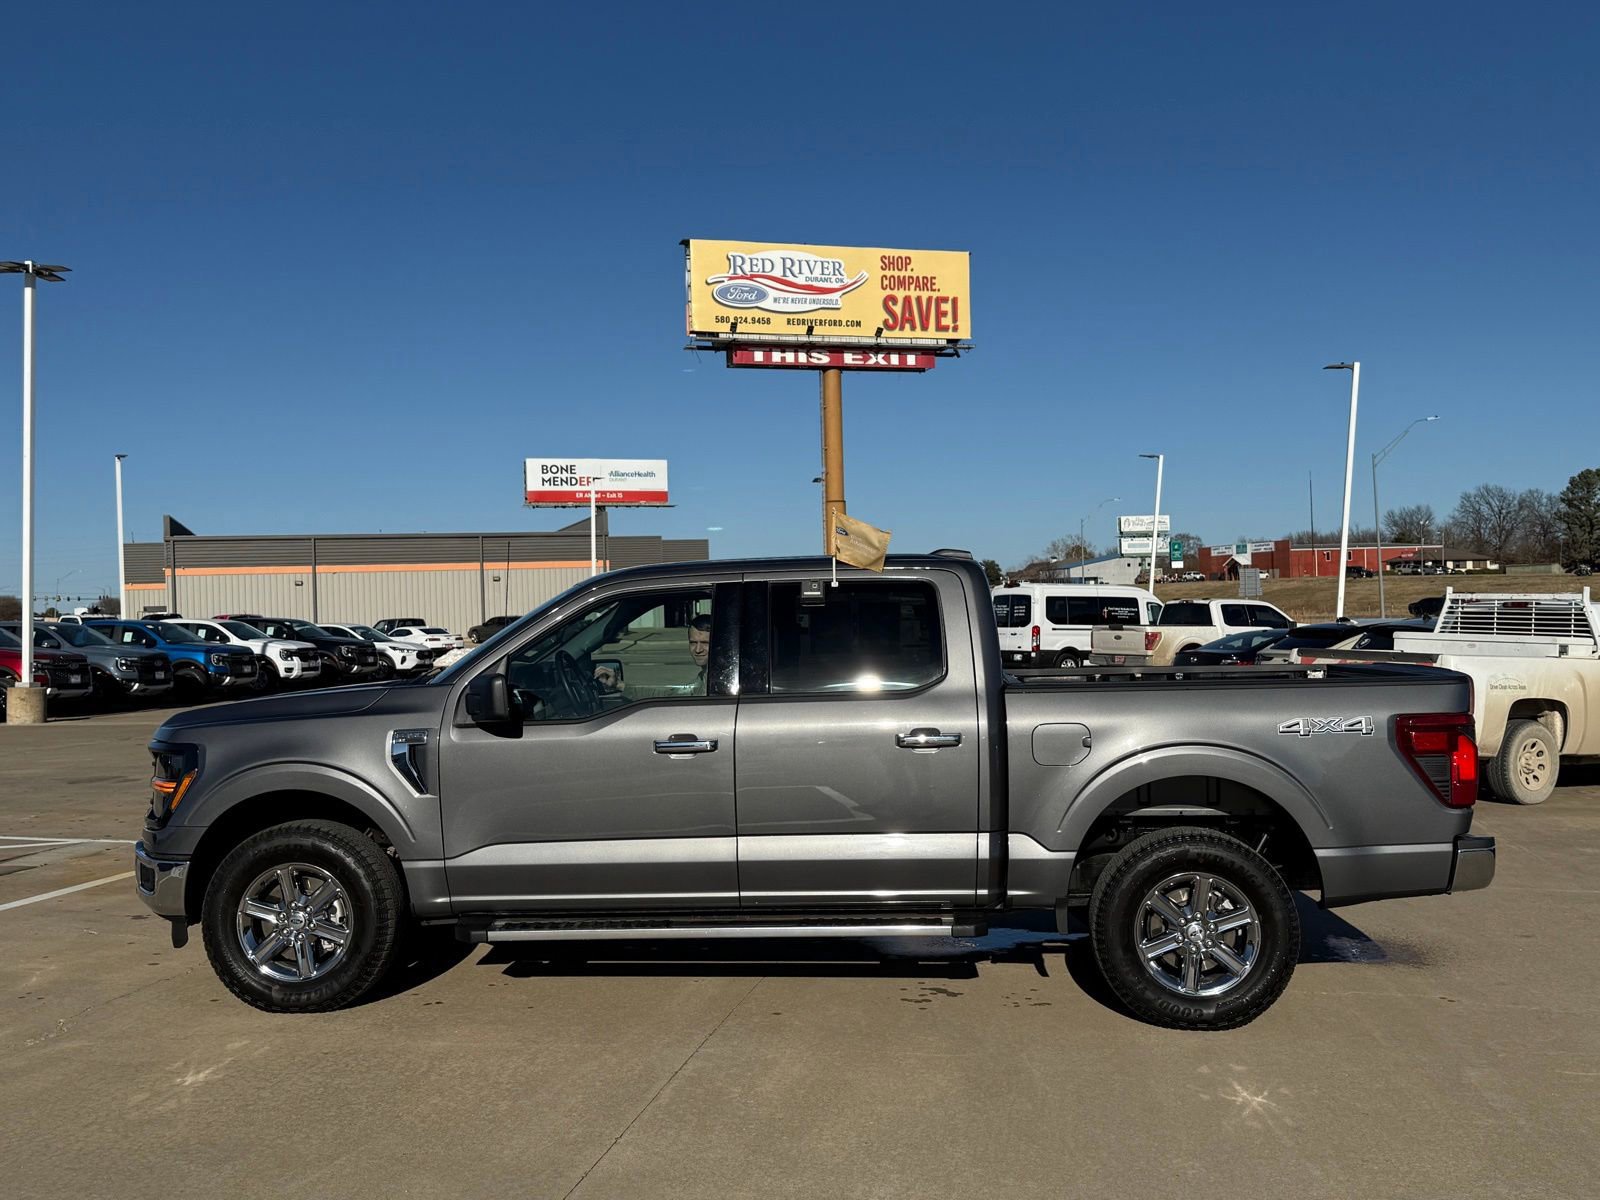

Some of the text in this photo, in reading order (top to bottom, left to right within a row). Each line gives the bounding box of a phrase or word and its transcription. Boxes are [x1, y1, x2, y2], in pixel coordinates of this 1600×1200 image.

[731, 254, 844, 278] RED RIVER
[880, 255, 914, 272] SHOP.
[881, 274, 941, 292] COMPARE.
[791, 297, 807, 305] NEVER
[809, 298, 840, 306] UNDERSOLD.
[715, 315, 771, 325] 580924.9458
[882, 294, 959, 332] SAVE!
[786, 317, 862, 328] REDRIVERFORD.COM
[749, 348, 921, 366] THIS EXIT
[541, 464, 576, 475] BONE
[609, 470, 656, 478] AllianceHealth
